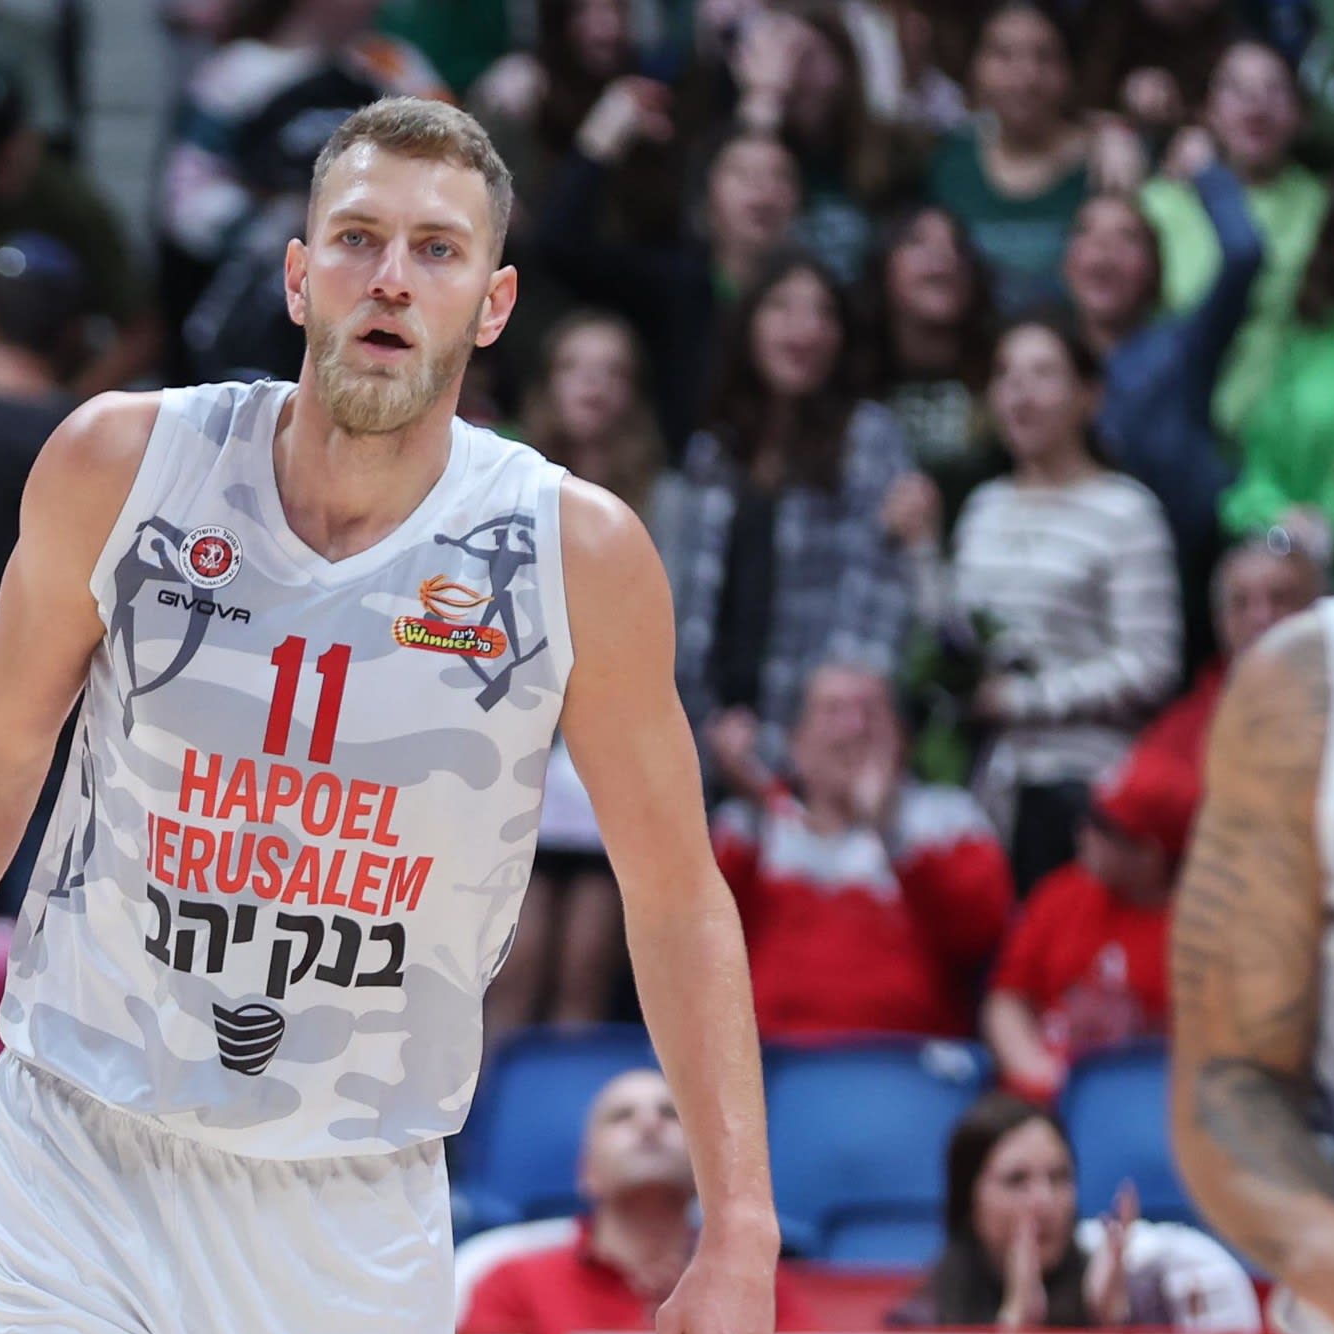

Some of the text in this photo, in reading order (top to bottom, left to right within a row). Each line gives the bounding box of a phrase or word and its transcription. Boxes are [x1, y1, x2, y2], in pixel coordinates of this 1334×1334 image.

[157, 589, 252, 625] GIVOVA
[450, 628, 476, 640] ליגת
[476, 638, 492, 652] סל
[262, 634, 353, 765] 11
[177, 747, 400, 848] HAPOEL
[145, 810, 435, 917] JERUSALEM
[144, 881, 407, 1001] בנק יהב
